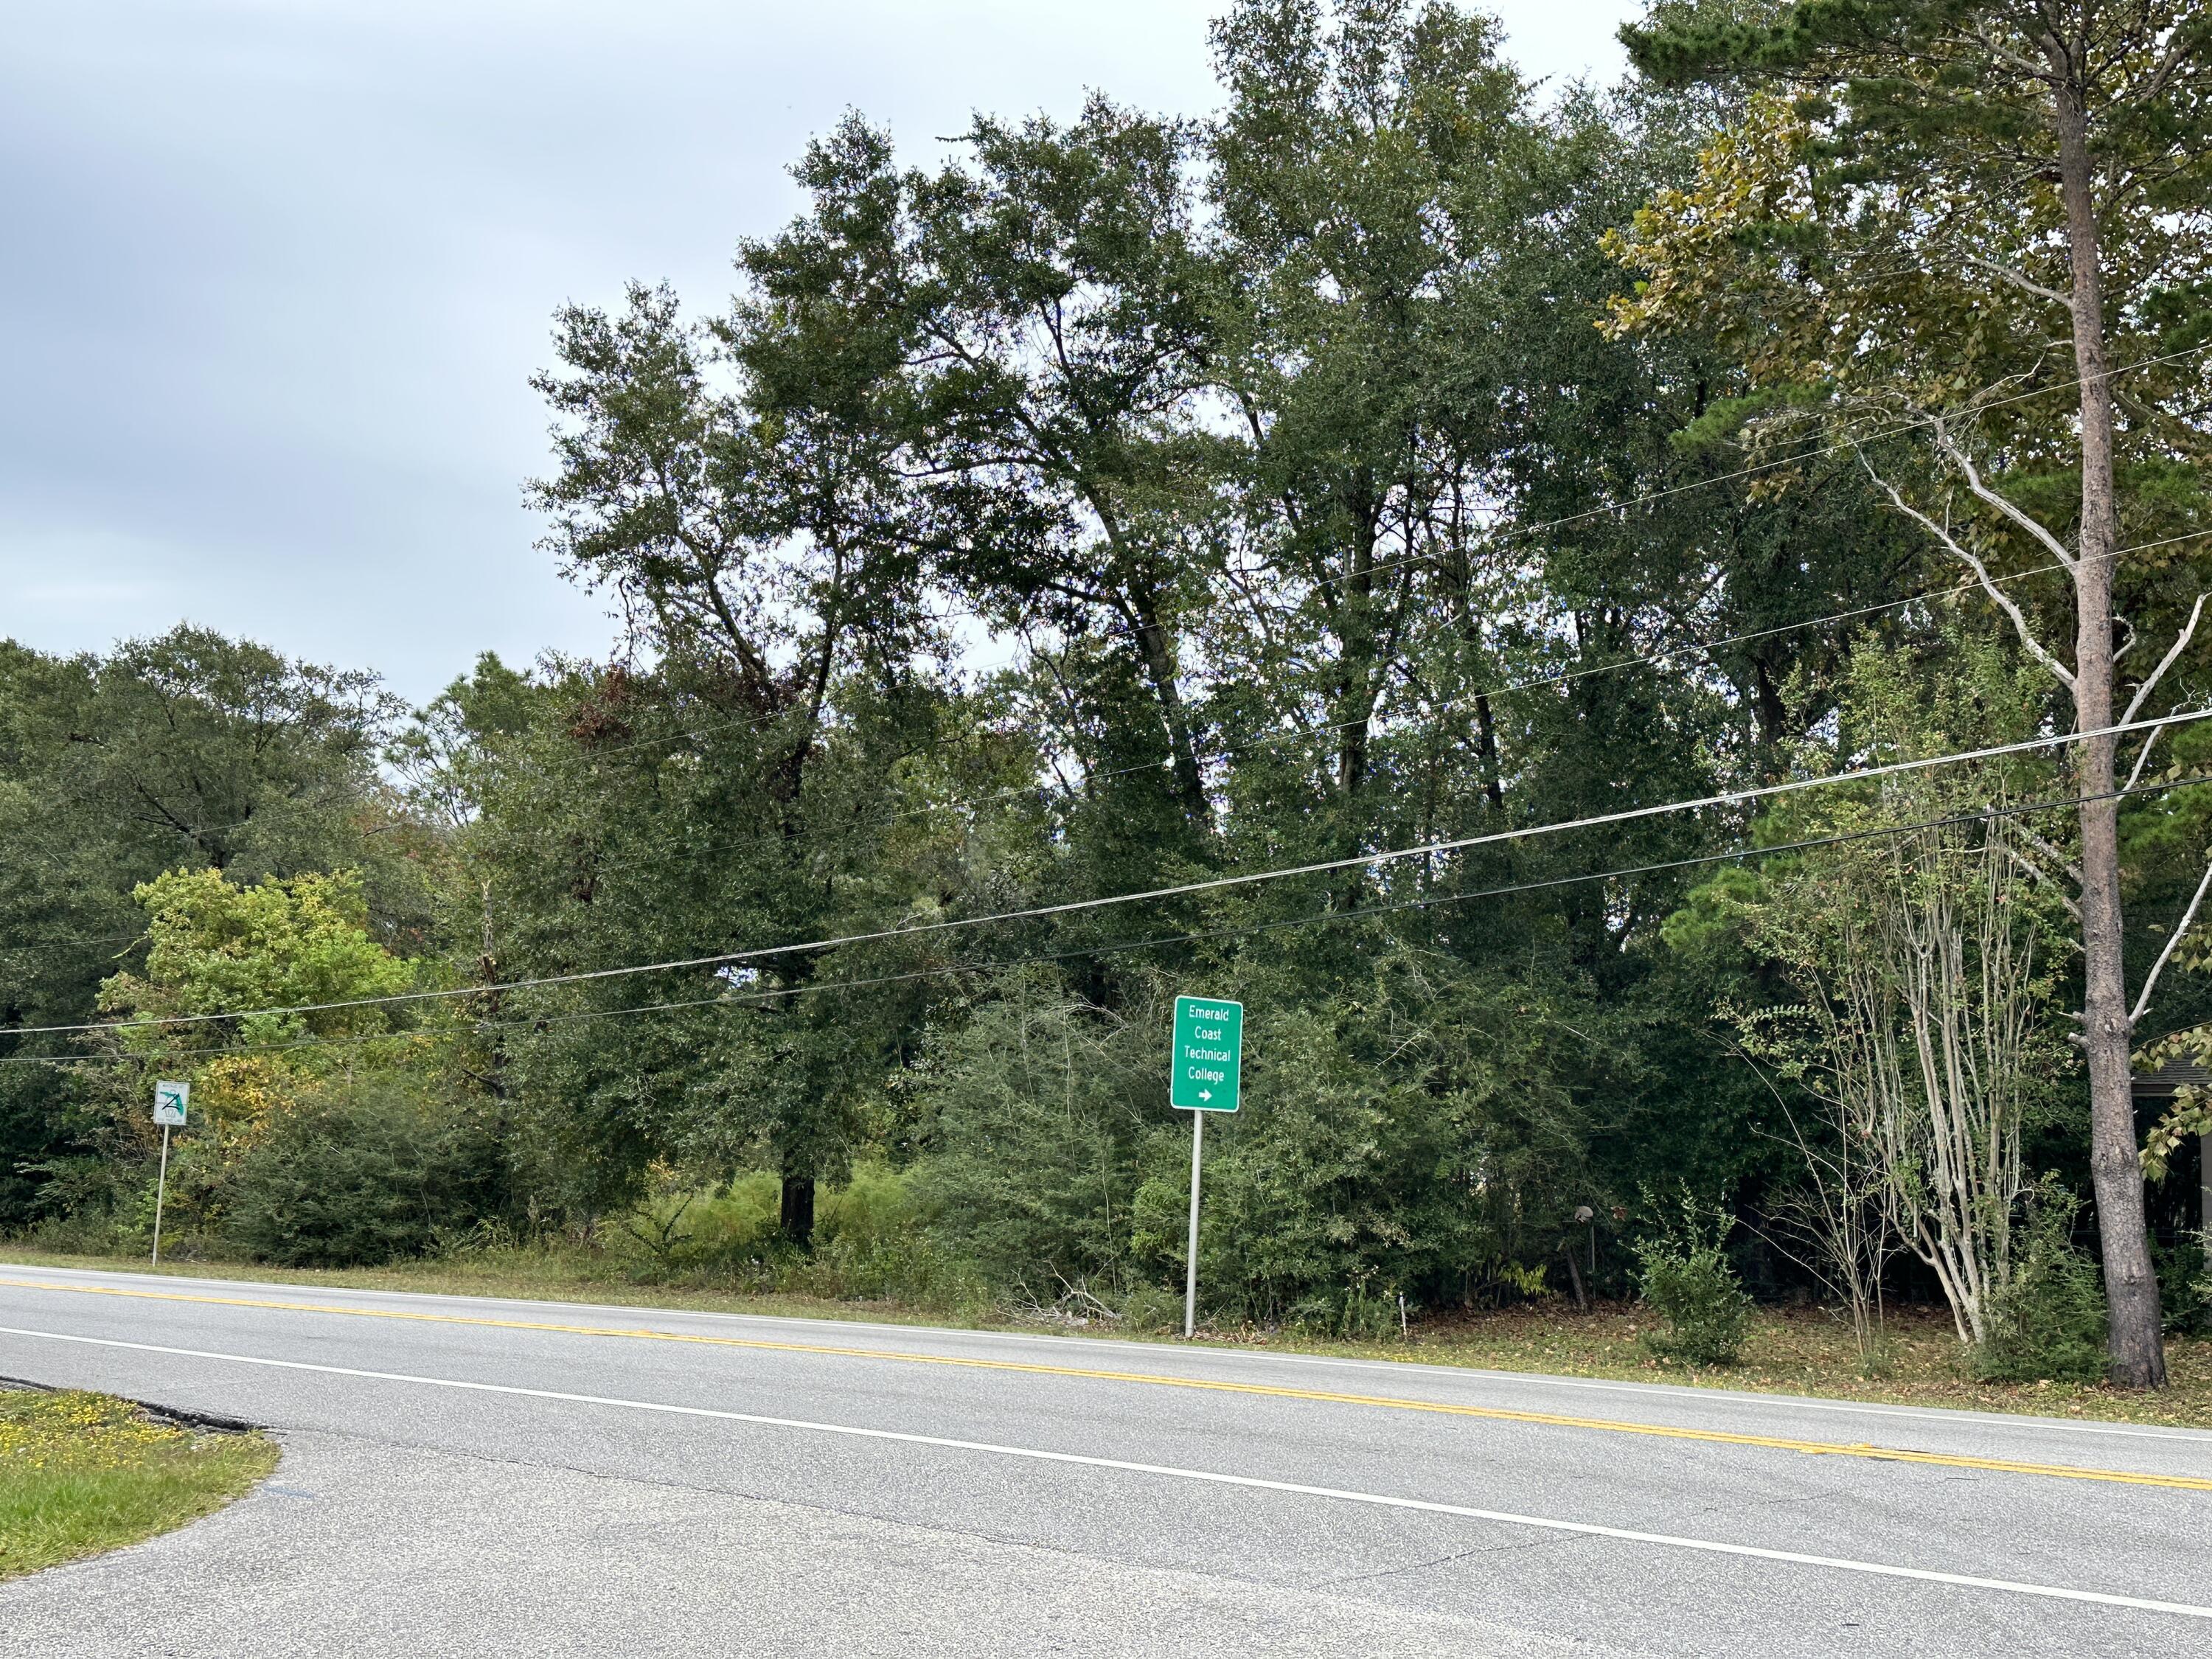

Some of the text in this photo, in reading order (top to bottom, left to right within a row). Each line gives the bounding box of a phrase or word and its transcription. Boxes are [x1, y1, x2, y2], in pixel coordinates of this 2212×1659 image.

[1189, 1004, 1229, 1021] Emerald
[1194, 1026, 1222, 1040] Coast
[1184, 1045, 1231, 1062] Technical
[1188, 1066, 1225, 1085] College
